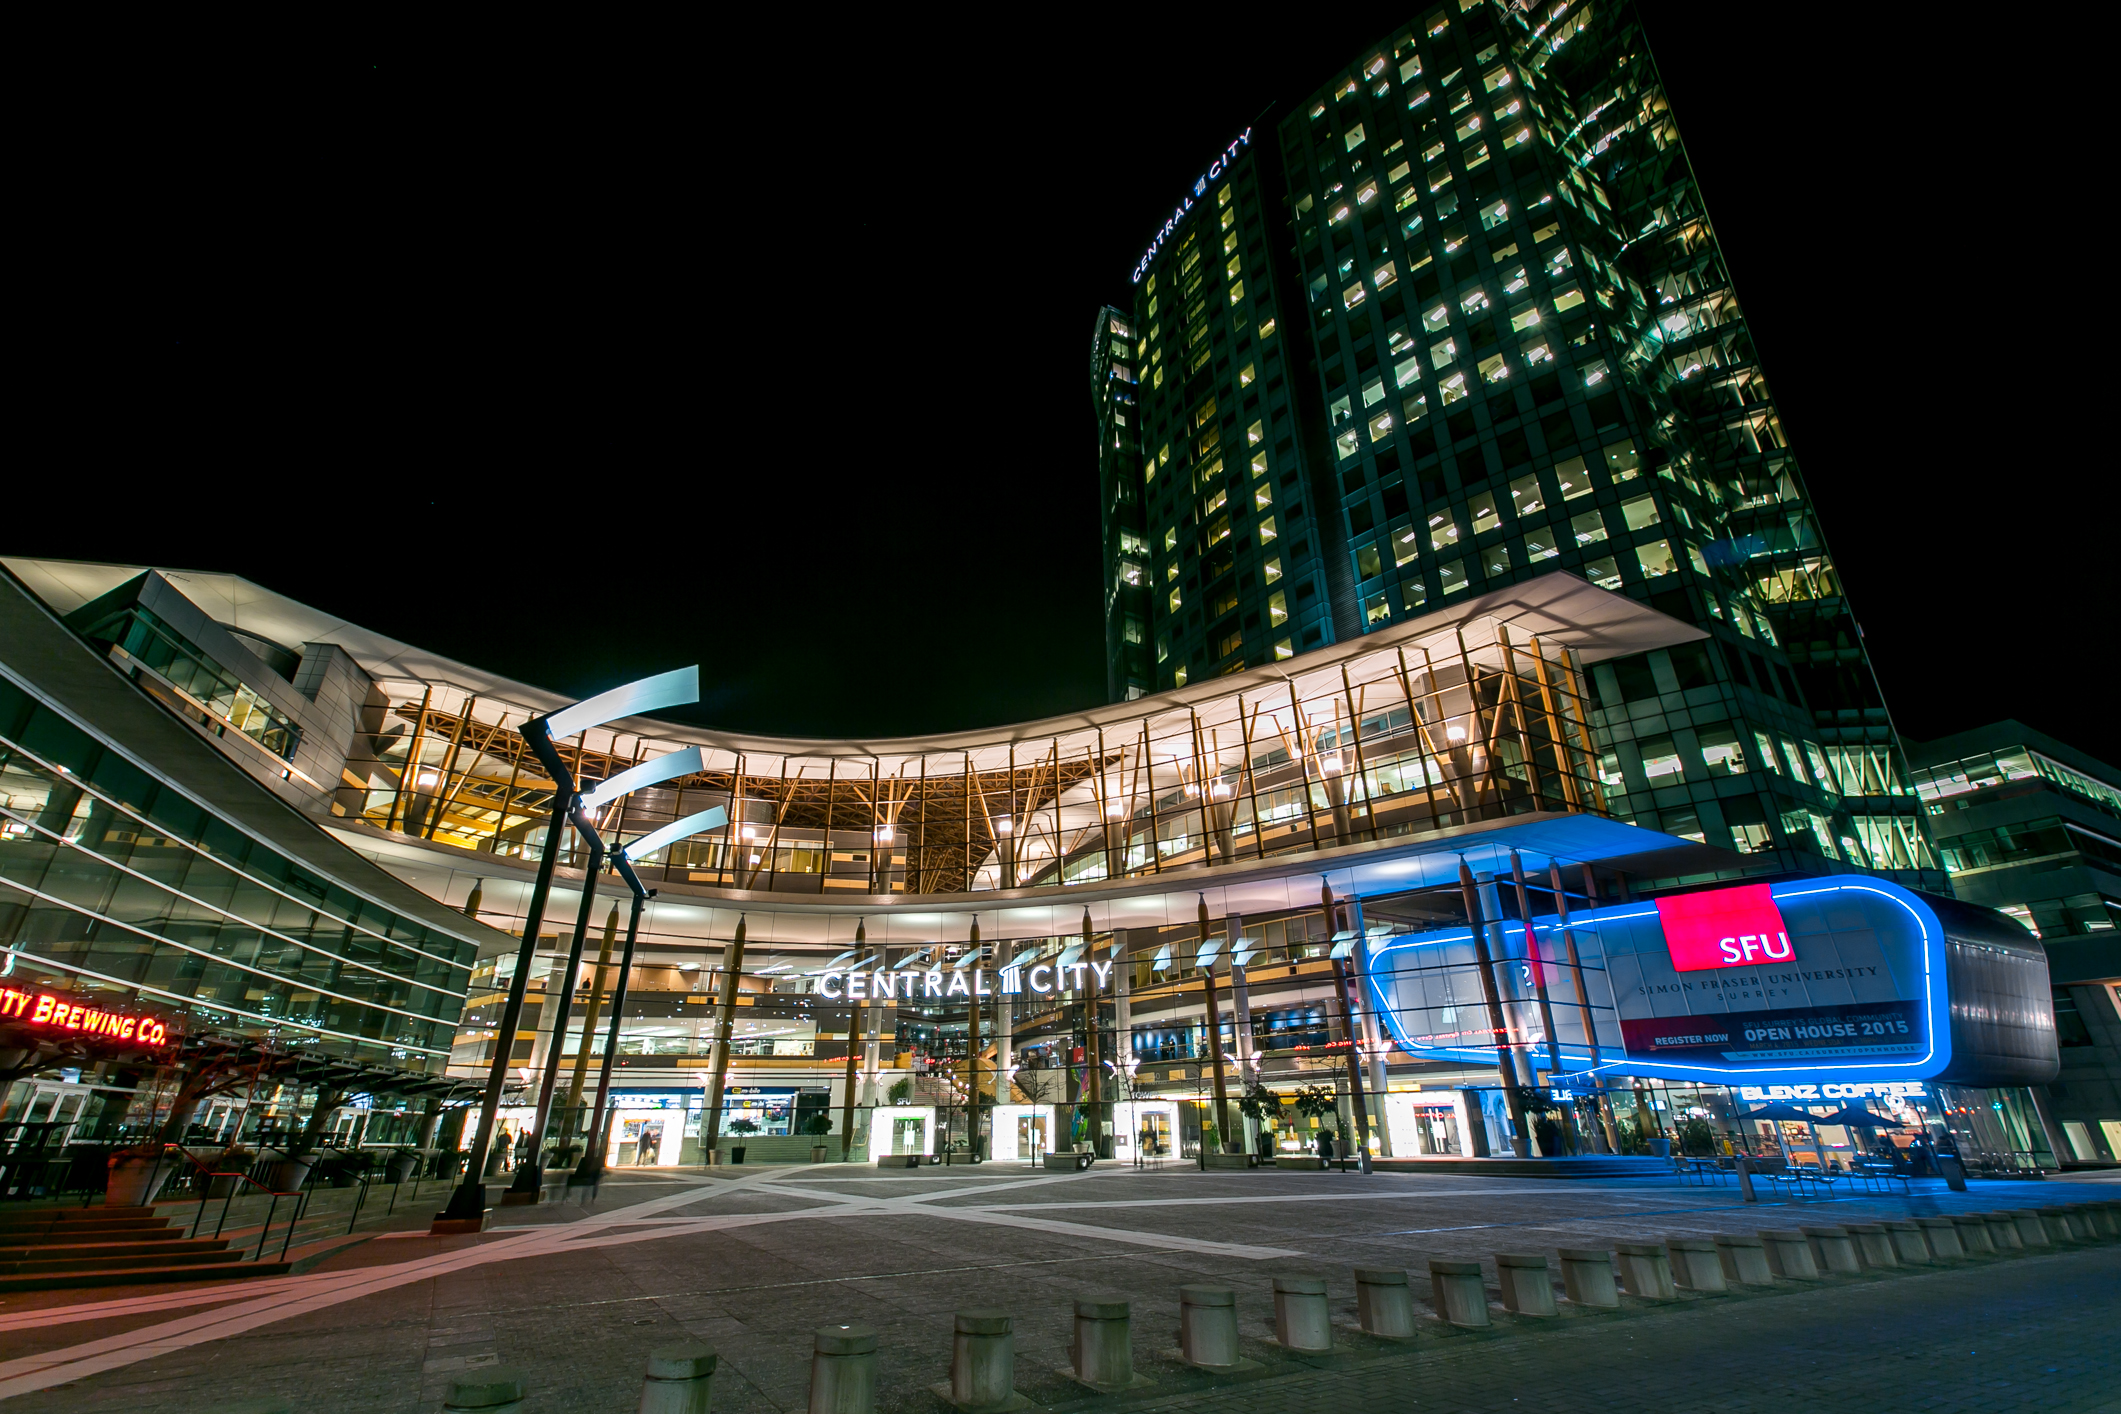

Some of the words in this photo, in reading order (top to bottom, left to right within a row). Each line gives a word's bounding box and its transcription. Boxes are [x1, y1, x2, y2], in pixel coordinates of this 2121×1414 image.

[1132, 197, 1194, 284] CENTRAL
[1208, 126, 1252, 180] CITY
[1718, 931, 1790, 963] SFU
[819, 968, 991, 999] CENTRAL
[1029, 961, 1113, 994] CITY
[1638, 982, 1693, 996] SIMON
[1701, 976, 1760, 990] FRASER
[1767, 966, 1878, 985] UNIVERSITY
[1717, 988, 1789, 1001] SURREY
[31, 994, 135, 1039] BREWING
[1742, 1021, 1760, 1029] SFU
[1762, 1018, 1806, 1028] SURREY'S
[1807, 1016, 1843, 1025] GLOBAL
[1846, 1012, 1904, 1023] COMMUNITY
[1654, 1034, 1702, 1046] REGISTER
[1704, 1033, 1729, 1043] NOW
[1744, 1027, 1791, 1042] OPEN
[1795, 1024, 1858, 1039] HOUSE
[1861, 1020, 1909, 1036] 2015
[1749, 1041, 1773, 1050] MARCH
[1802, 1037, 1845, 1047] WEDNESDAY
[896, 1097, 911, 1106] SFU
[1740, 1084, 1821, 1101] BLENZ
[1822, 1082, 1927, 1099] COFFEE
